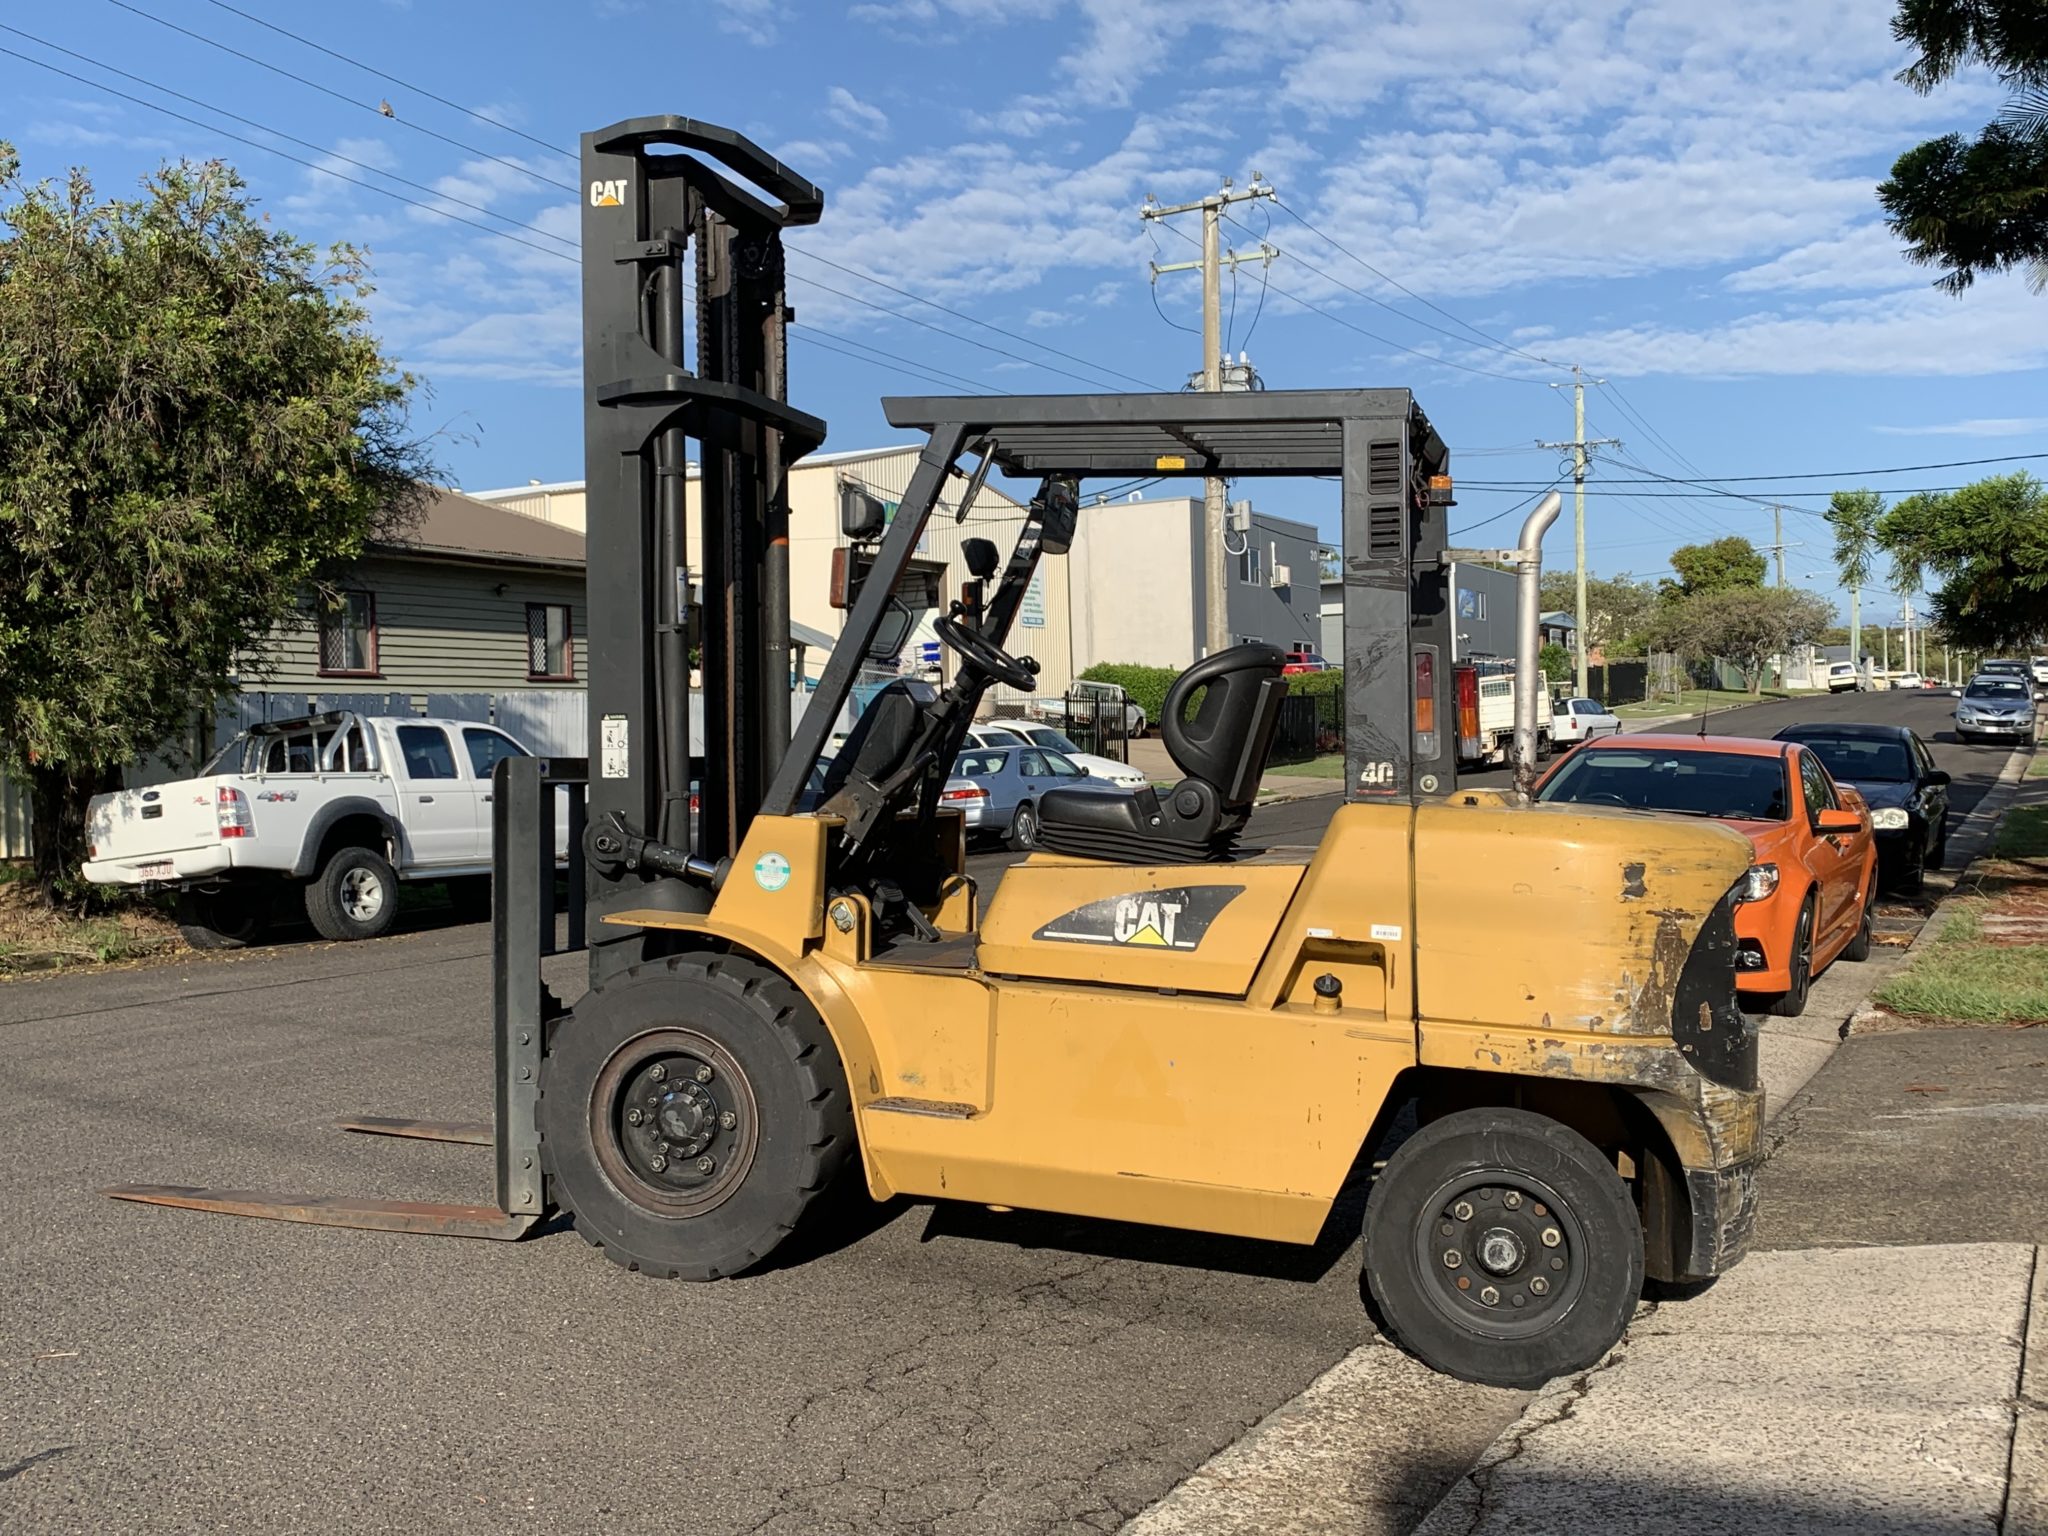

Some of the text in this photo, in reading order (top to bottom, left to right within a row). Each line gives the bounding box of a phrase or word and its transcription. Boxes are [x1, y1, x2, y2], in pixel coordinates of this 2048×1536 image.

[591, 179, 628, 207] CAT
[1310, 549, 1318, 562] 20
[1361, 762, 1393, 786] 40
[1114, 898, 1182, 947] CAT
